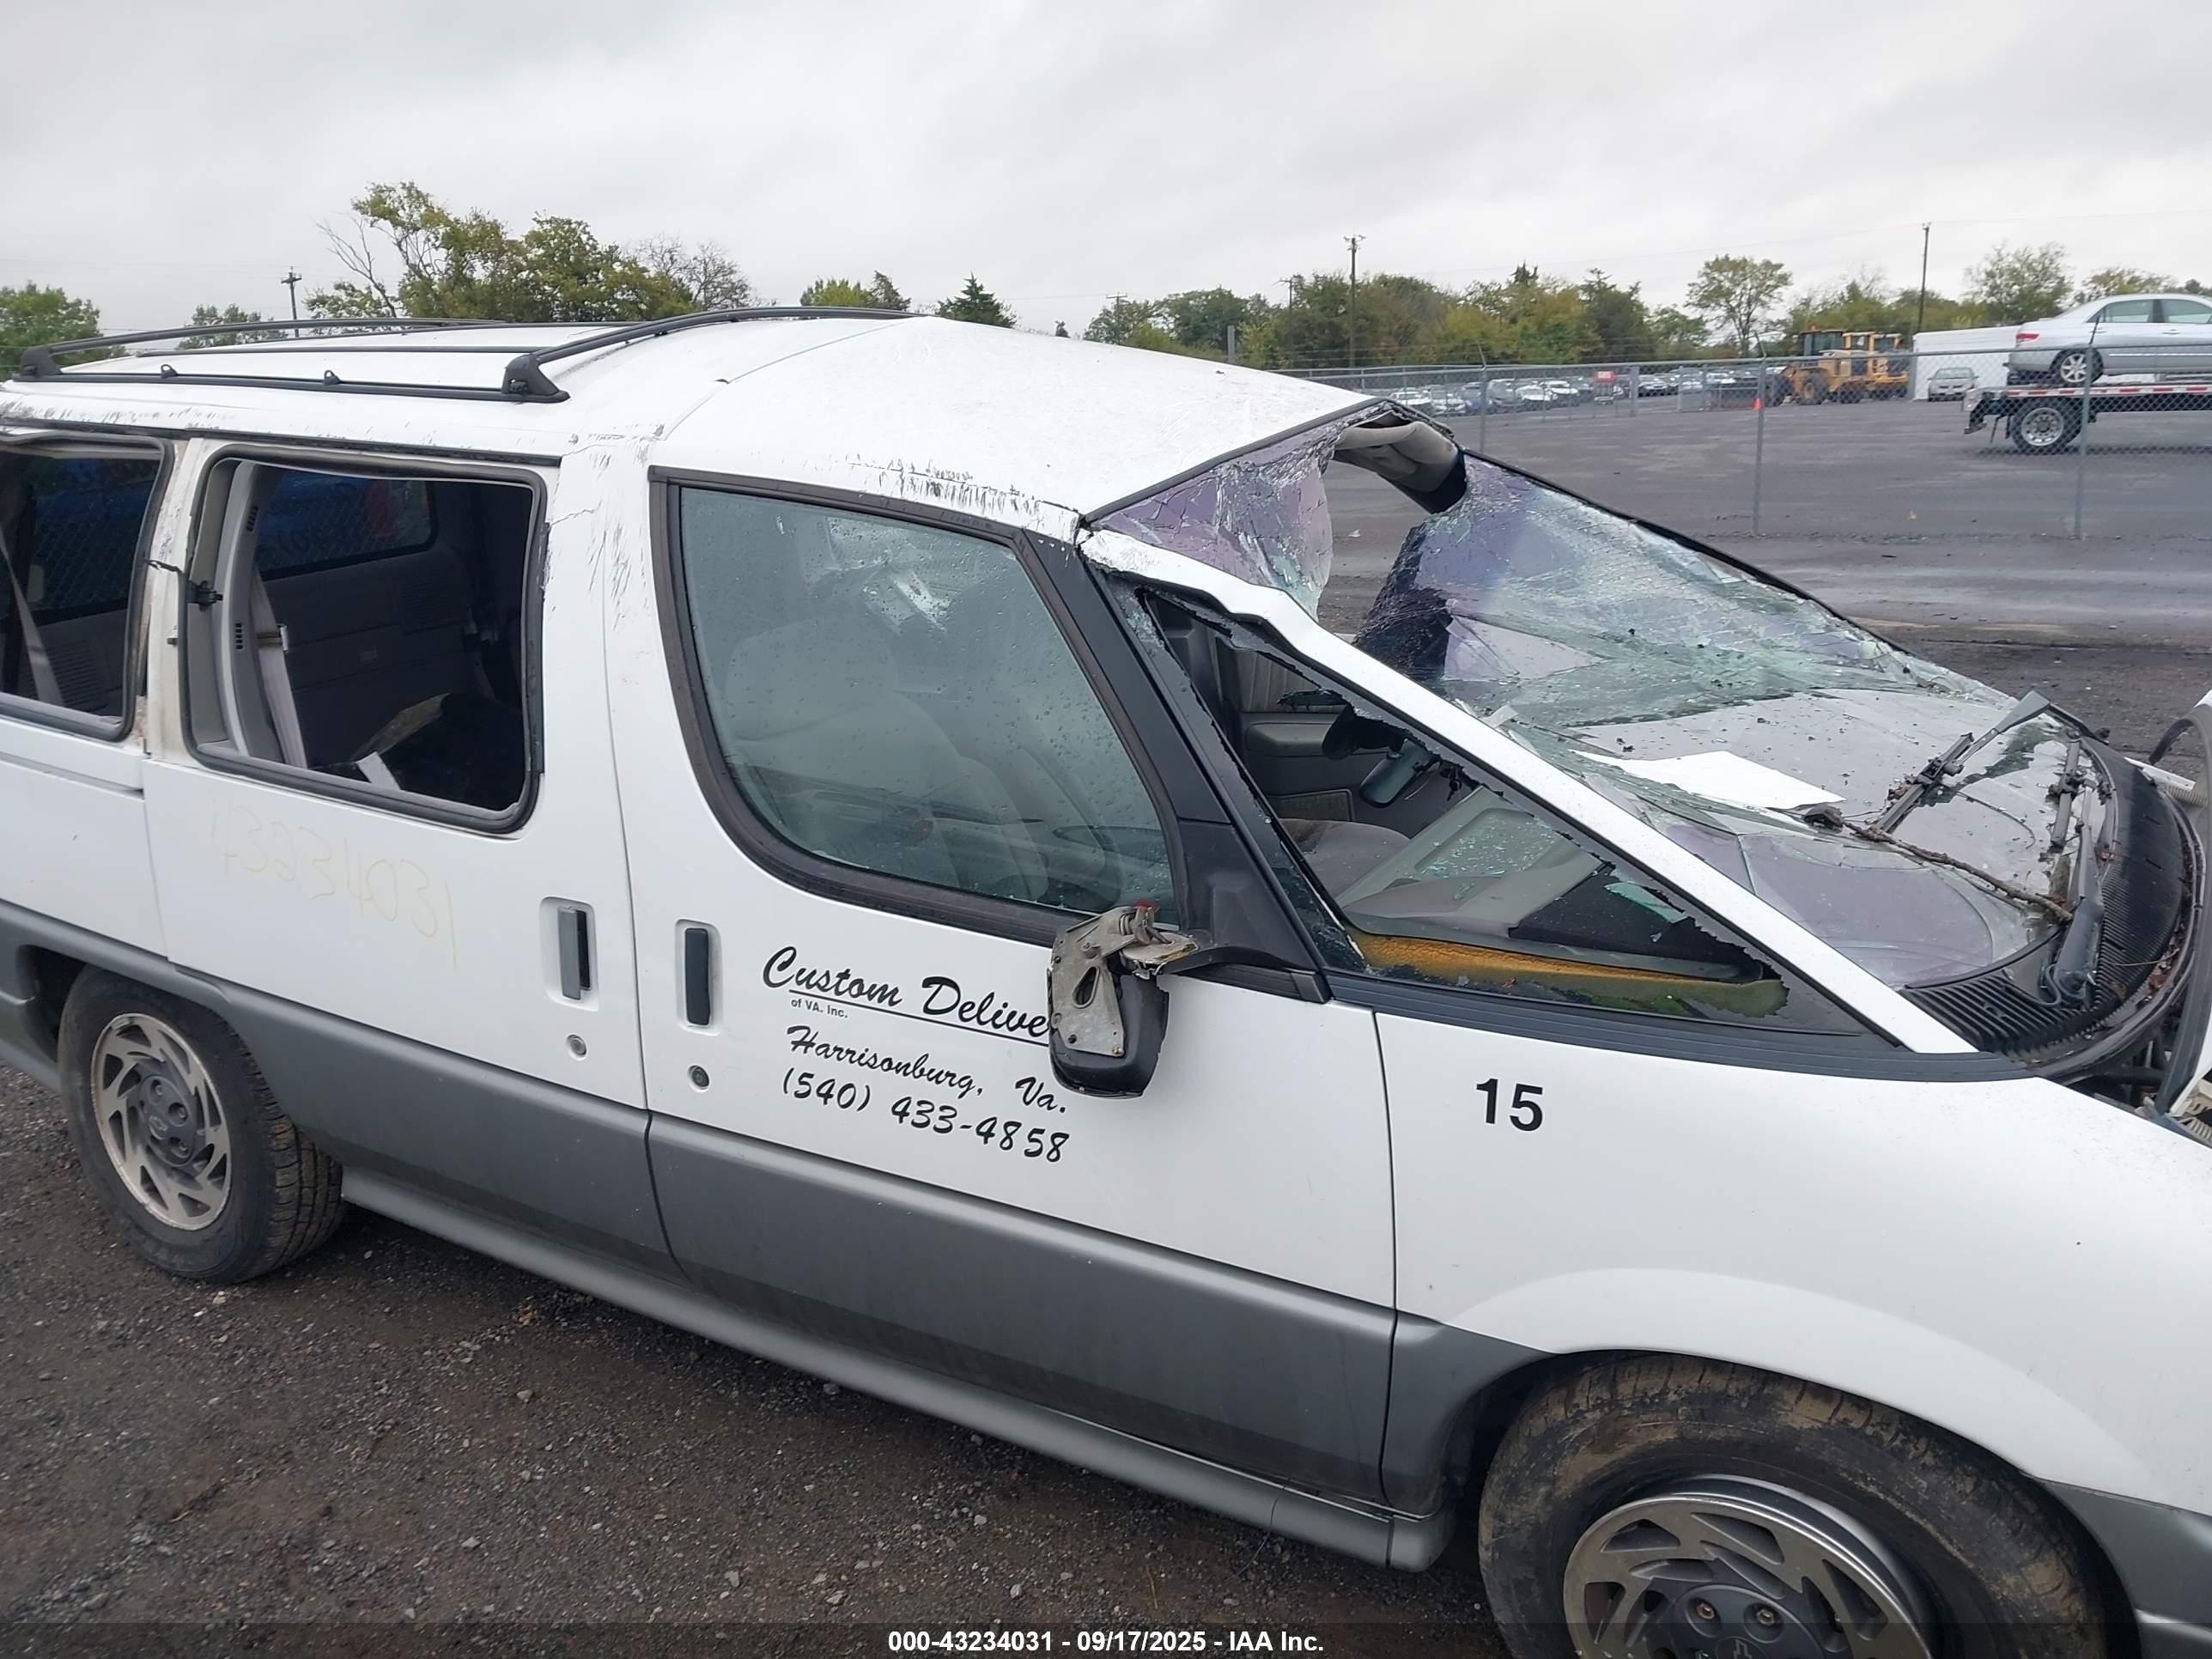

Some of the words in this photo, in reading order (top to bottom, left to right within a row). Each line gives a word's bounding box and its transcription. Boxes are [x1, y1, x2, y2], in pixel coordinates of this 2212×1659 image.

[763, 946, 902, 1006] Custom
[922, 976, 1049, 1036] Delive
[791, 999, 802, 1008] of
[805, 1000, 823, 1012] VA.
[827, 1005, 848, 1018] Inc.
[787, 1026, 983, 1099] Harrisonburg,
[1016, 1077, 1066, 1113] Va.
[1476, 1079, 1543, 1131] 15
[783, 1068, 872, 1112] (540)
[891, 1097, 1070, 1163] 433-4858
